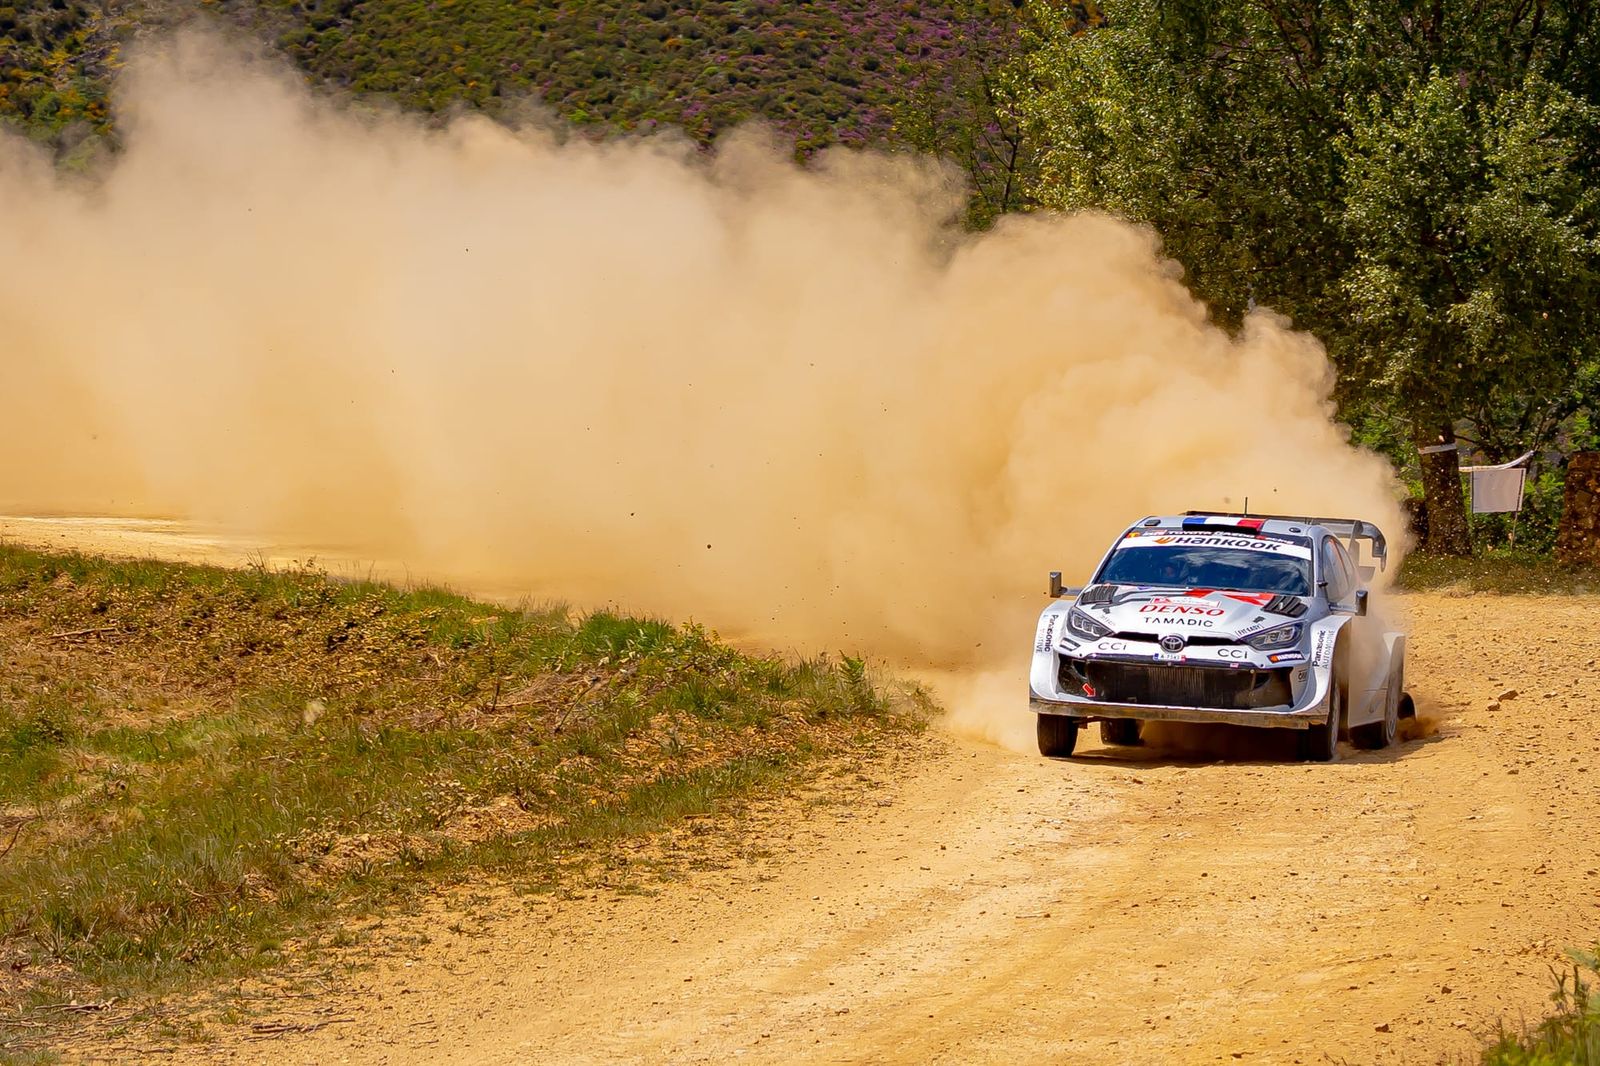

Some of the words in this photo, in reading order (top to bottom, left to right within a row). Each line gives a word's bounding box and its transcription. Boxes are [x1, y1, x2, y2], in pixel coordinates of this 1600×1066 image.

[1139, 605, 1225, 616] DENSO
[1143, 617, 1214, 627] TAMADIC
[1097, 642, 1127, 651] CCI
[1311, 630, 1326, 667] Panasonic
[1217, 648, 1248, 659] CCI
